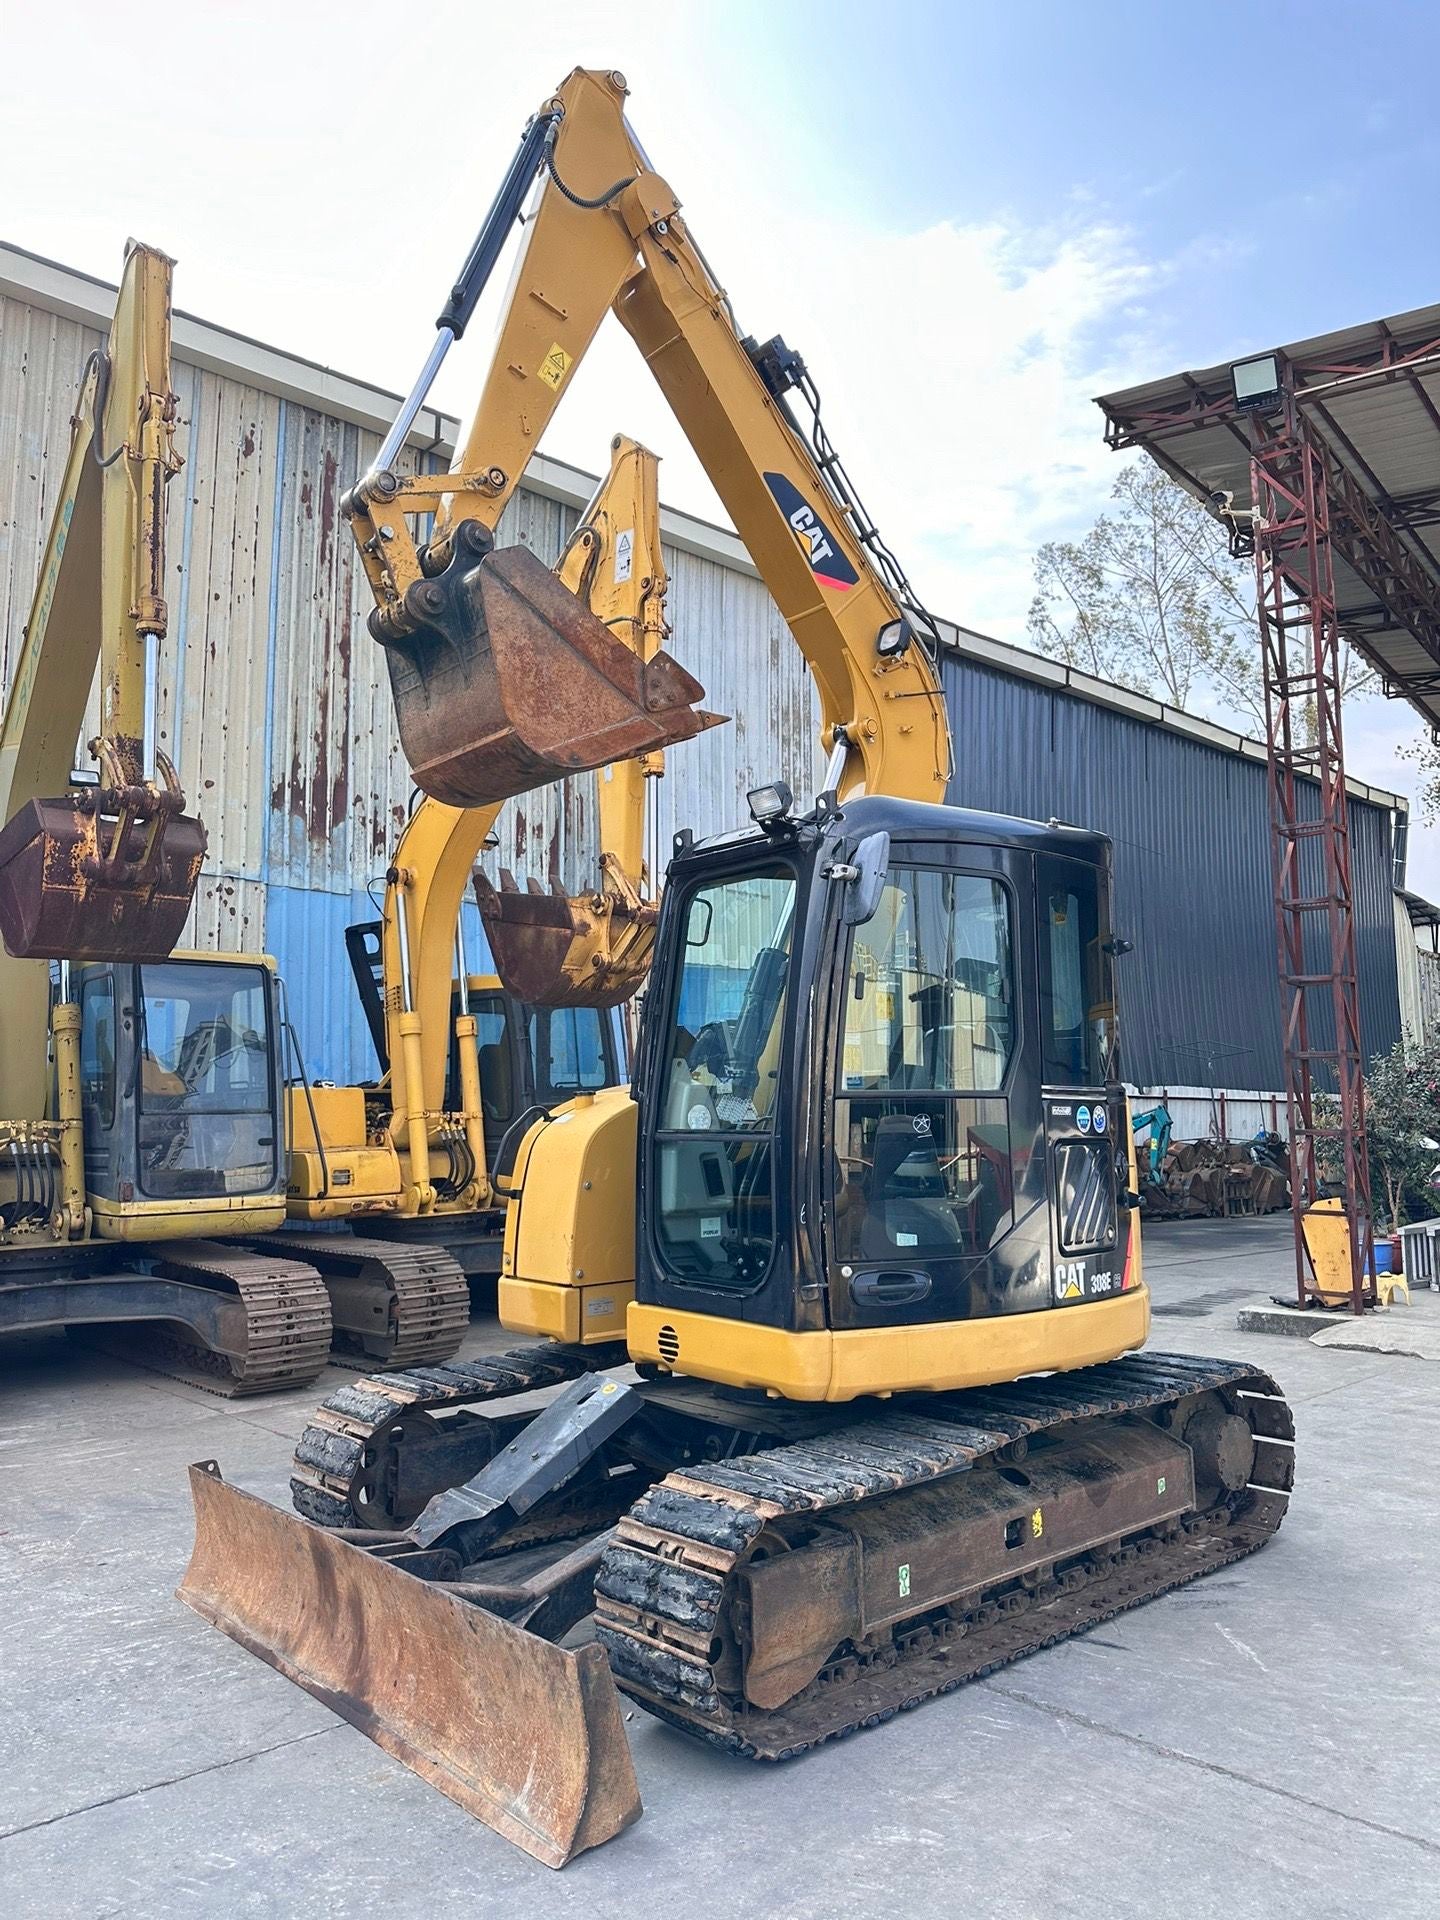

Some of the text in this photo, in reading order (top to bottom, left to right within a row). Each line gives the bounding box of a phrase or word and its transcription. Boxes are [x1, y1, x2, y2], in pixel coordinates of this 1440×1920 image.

[790, 505, 834, 565] CAT
[1055, 1261, 1086, 1299] CAT
[1090, 1271, 1112, 1294] 308E
